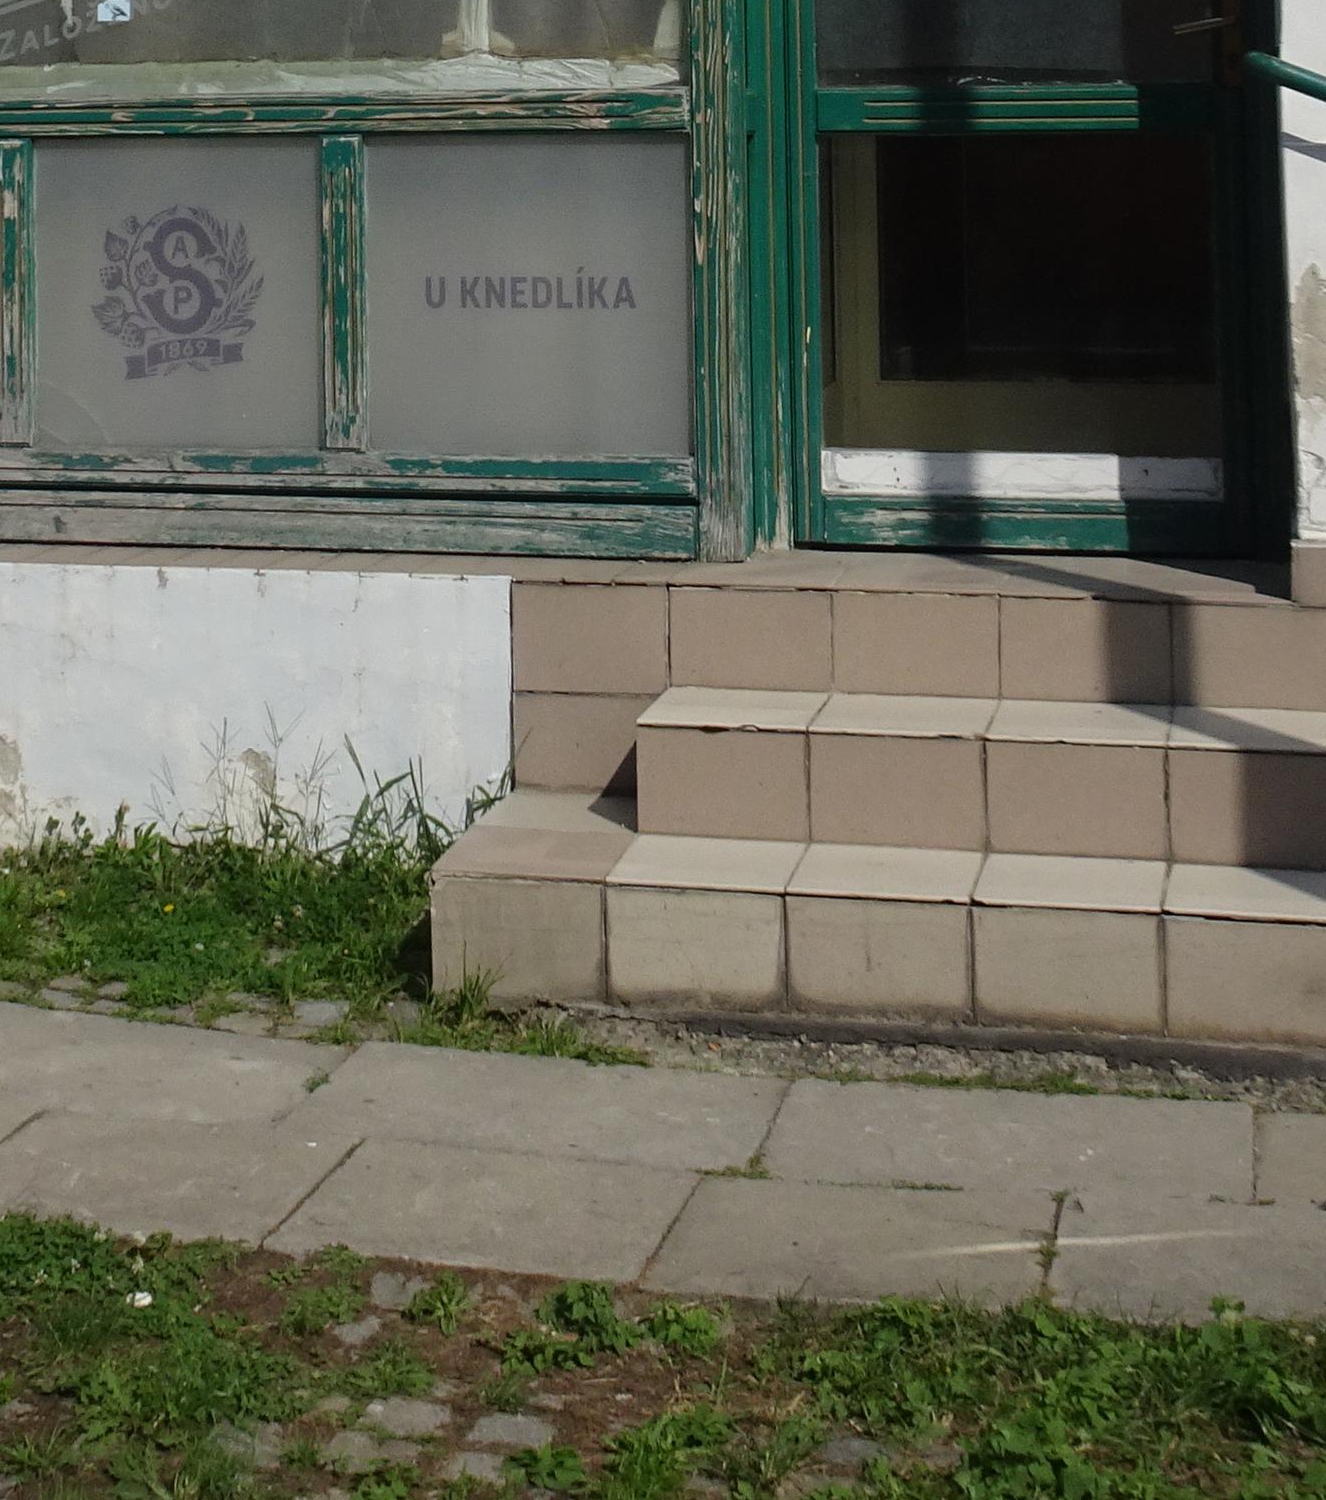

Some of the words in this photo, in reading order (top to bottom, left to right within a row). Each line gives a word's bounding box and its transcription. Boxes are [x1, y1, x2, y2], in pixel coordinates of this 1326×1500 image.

[425, 275, 447, 310] U
[461, 266, 636, 311] KNEDLÍKA
[160, 339, 208, 361] 1869
